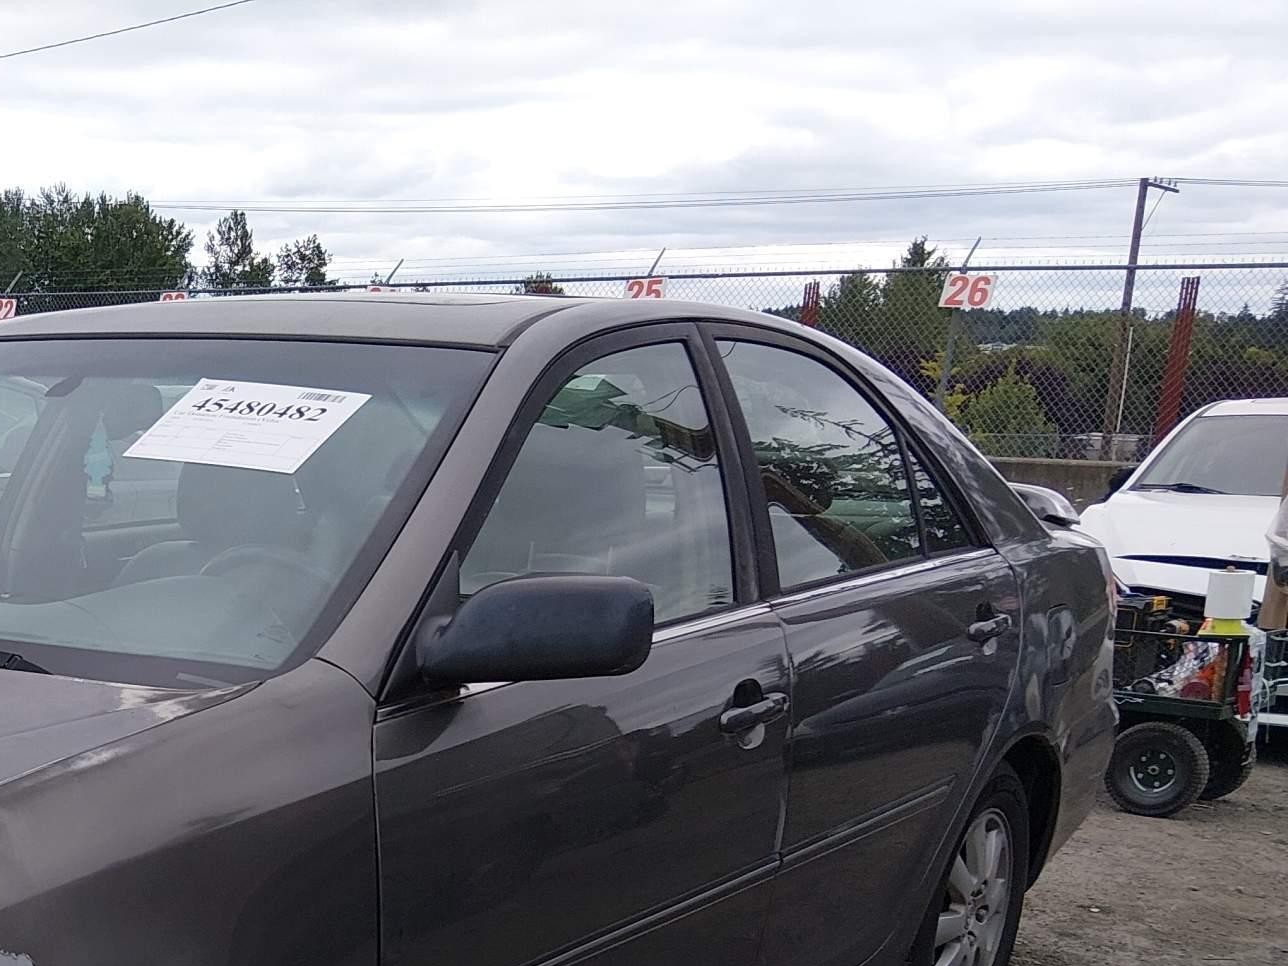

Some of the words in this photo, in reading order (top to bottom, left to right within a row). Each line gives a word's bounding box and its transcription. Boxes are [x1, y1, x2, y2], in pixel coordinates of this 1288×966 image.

[627, 279, 664, 298] 25
[943, 275, 992, 307] 26
[191, 396, 328, 422] 45480482
